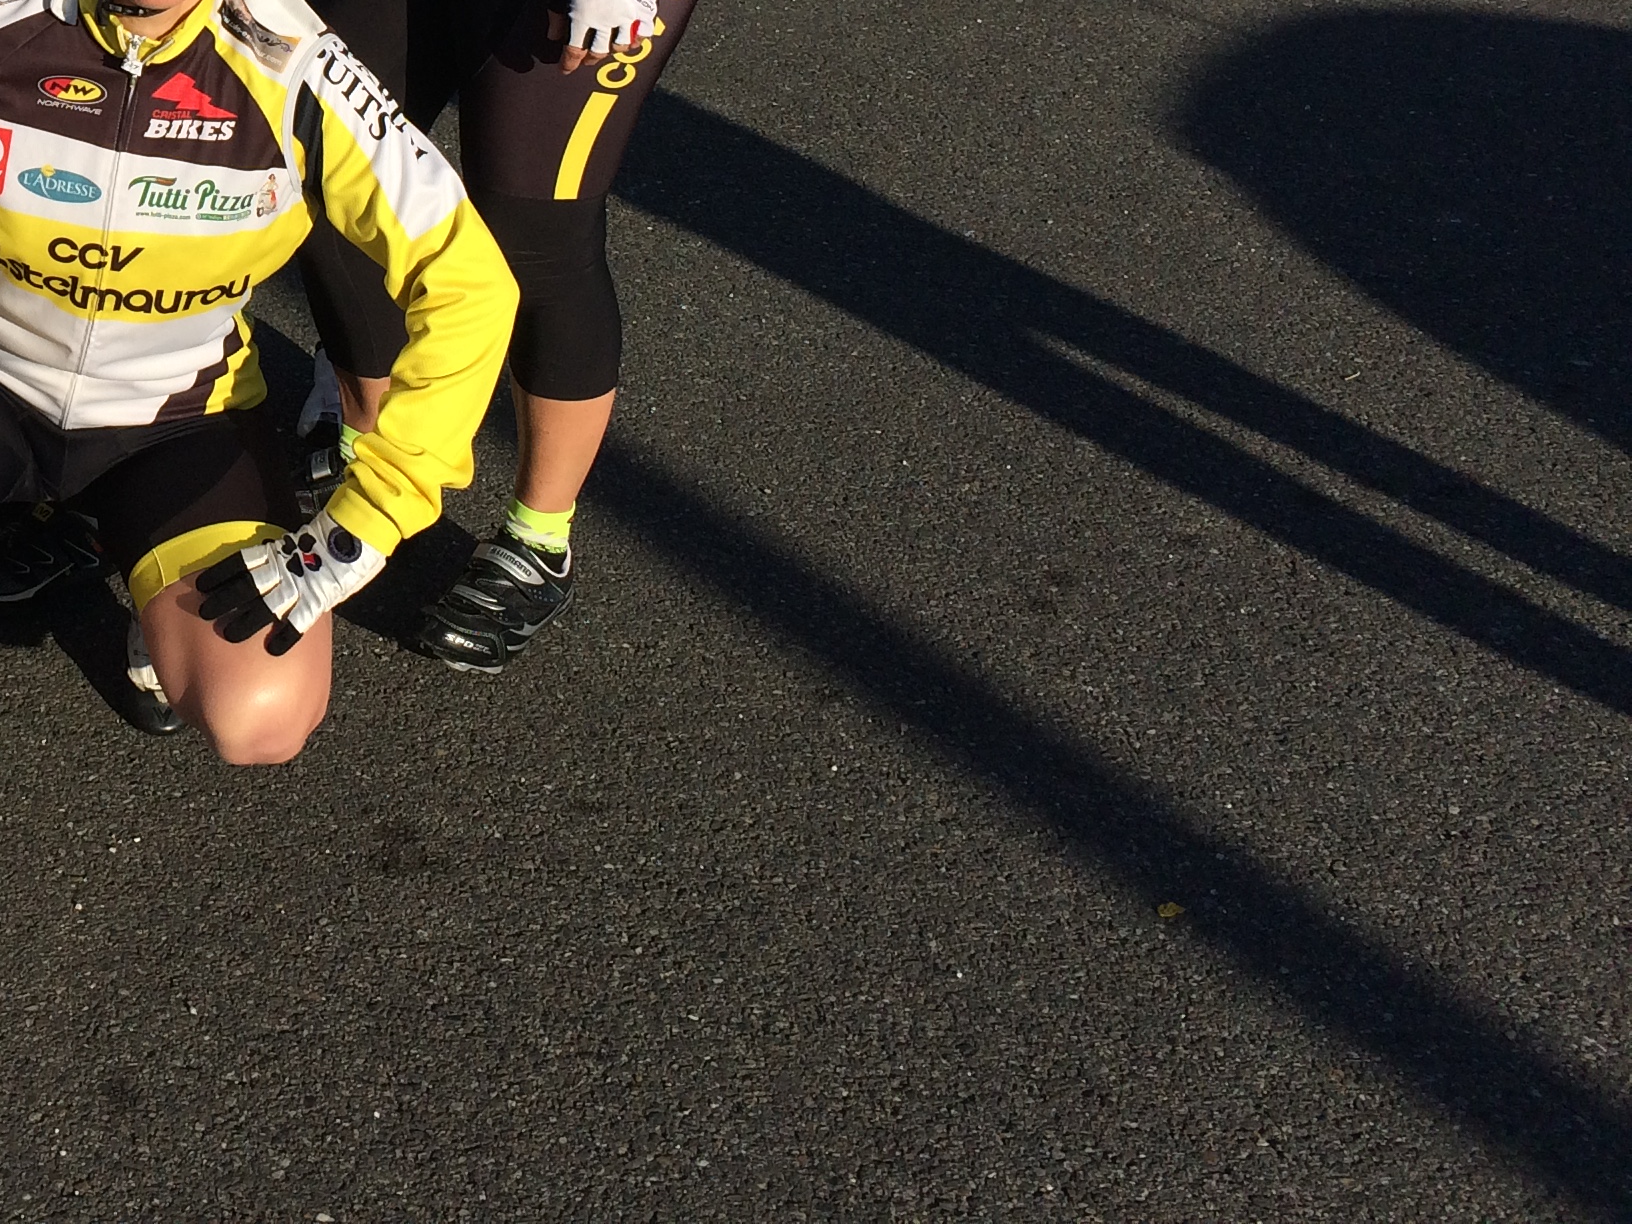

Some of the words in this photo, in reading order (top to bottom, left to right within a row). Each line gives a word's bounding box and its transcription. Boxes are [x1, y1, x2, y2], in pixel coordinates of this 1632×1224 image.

[48, 78, 96, 99] NW
[37, 98, 103, 116] NORTHWAVE
[152, 108, 194, 122] CRISTAL
[143, 118, 238, 142] BIKES
[127, 176, 191, 211] Tutti
[194, 179, 255, 212] Pizza
[489, 545, 533, 578] SHIMANO
